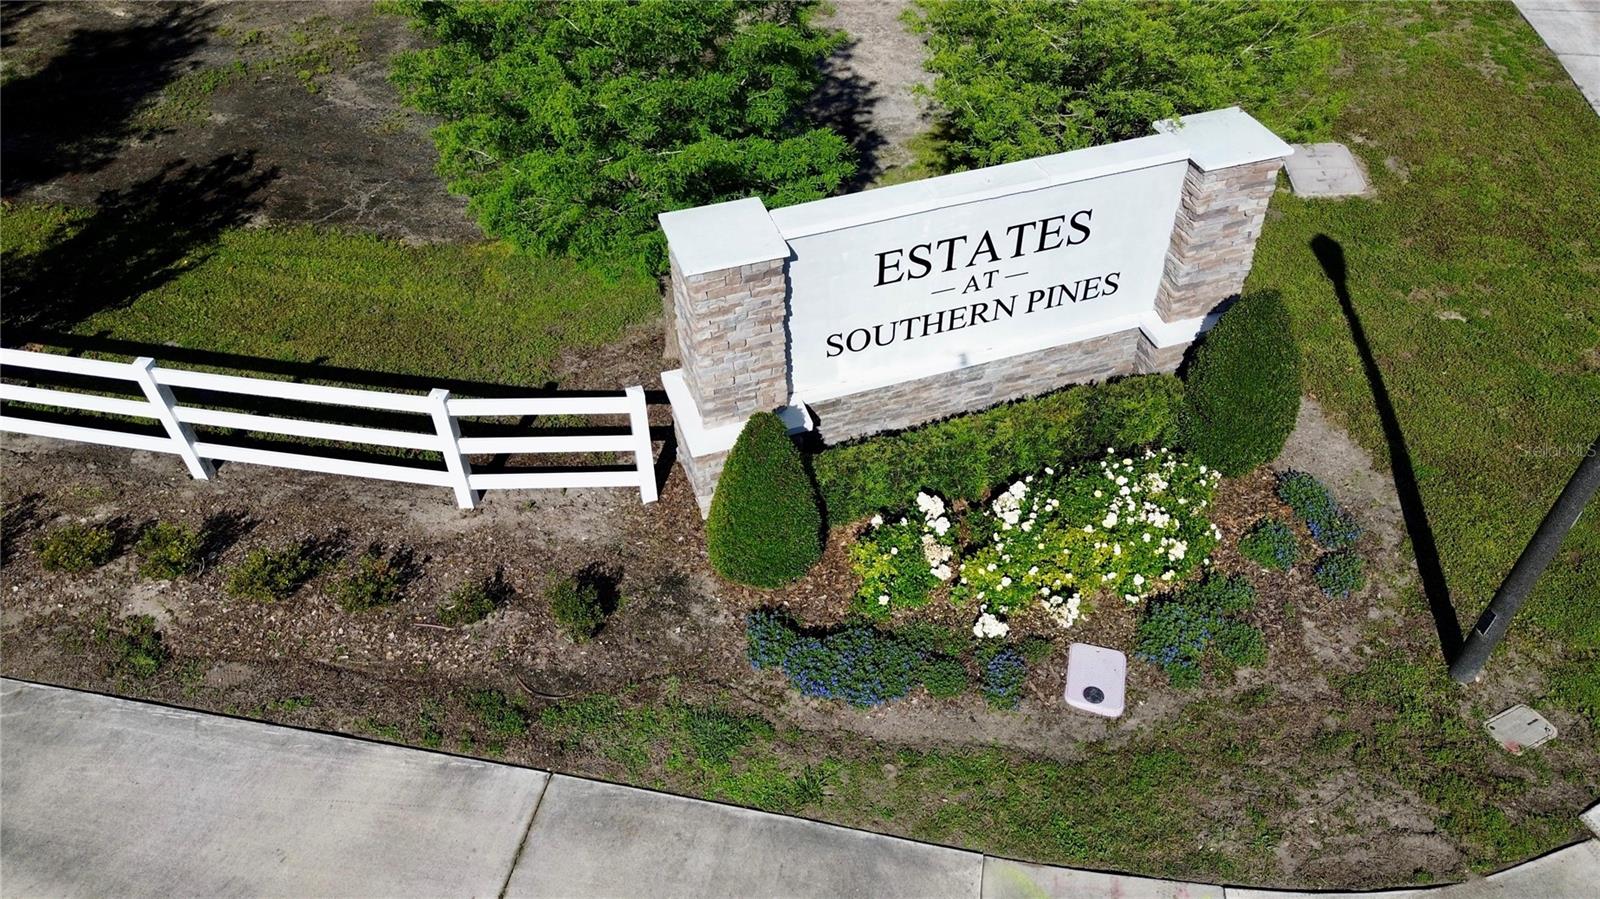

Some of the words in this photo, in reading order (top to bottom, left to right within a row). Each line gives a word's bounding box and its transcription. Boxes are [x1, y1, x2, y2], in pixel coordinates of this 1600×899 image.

[873, 208, 1093, 288] ESTATES
[961, 269, 1000, 295] AT
[825, 294, 1019, 358] SOUTHERN
[1025, 271, 1121, 314] PINES
